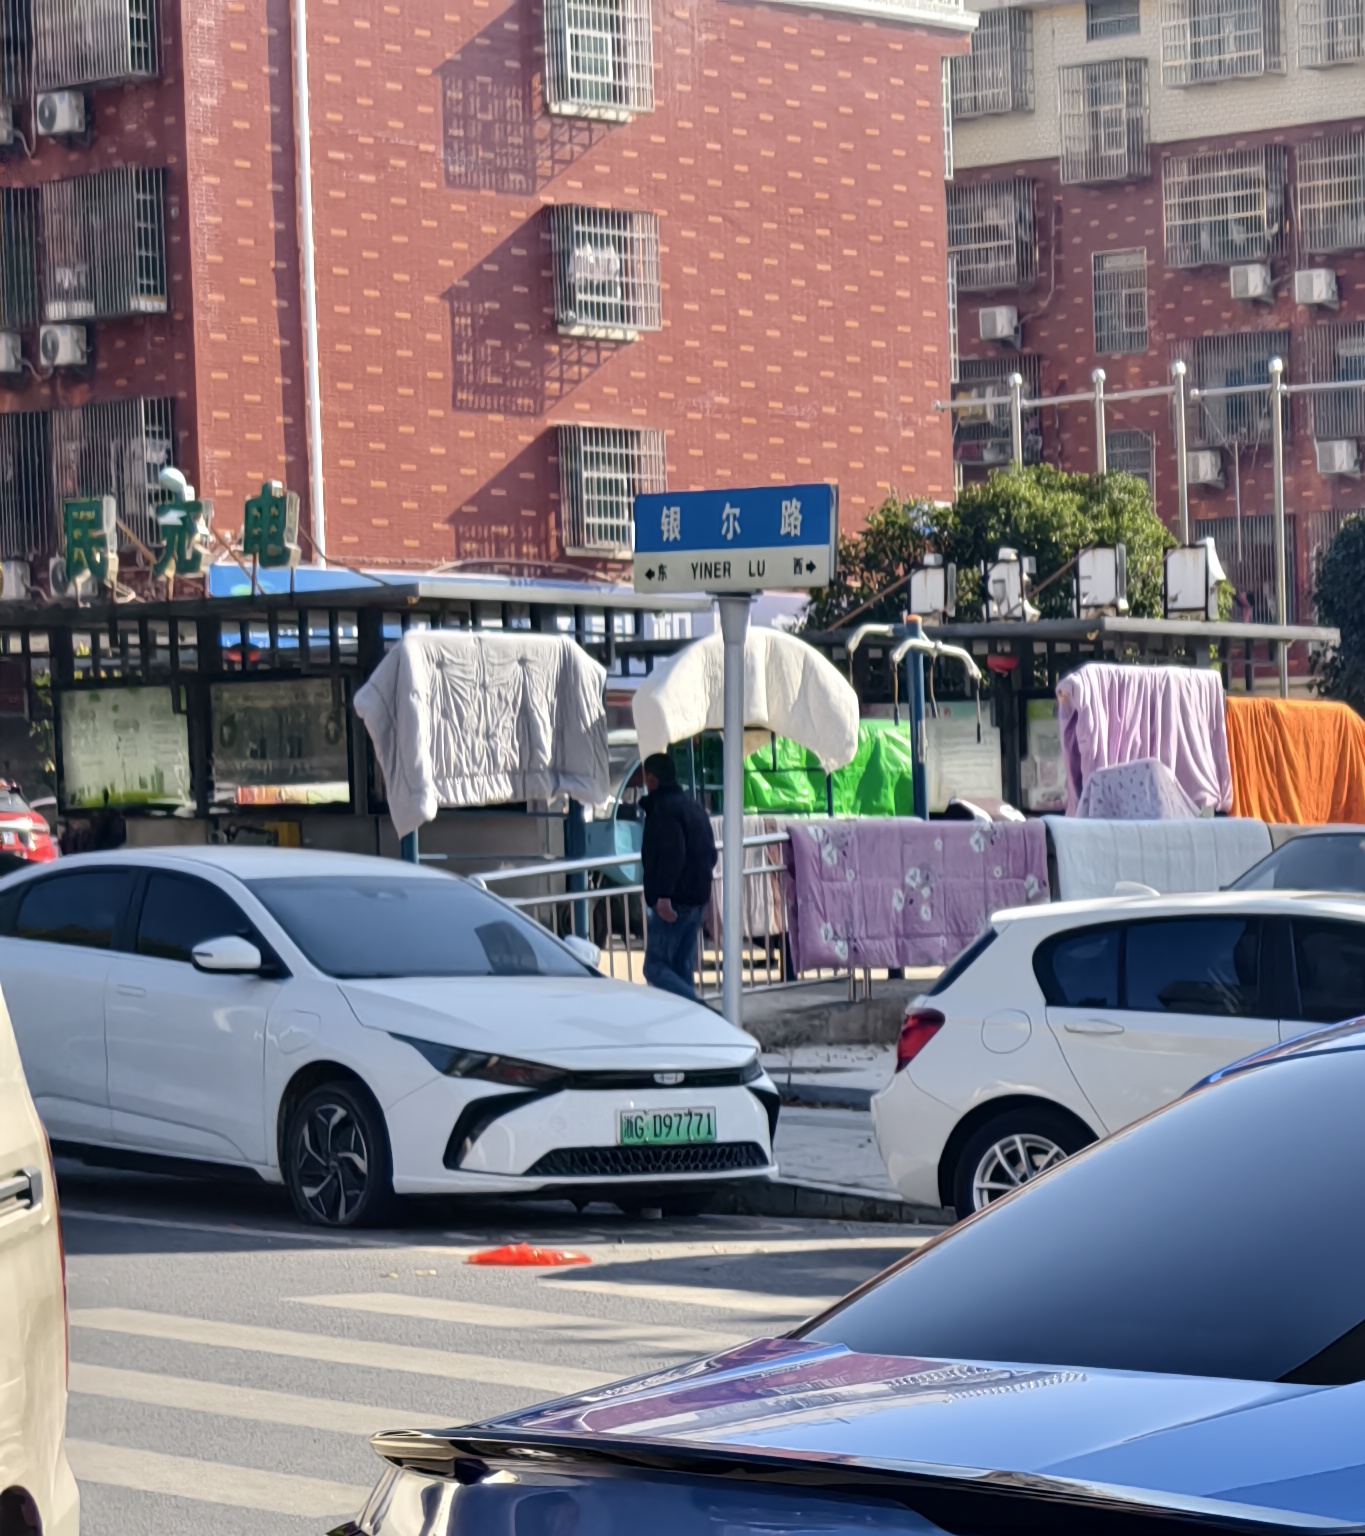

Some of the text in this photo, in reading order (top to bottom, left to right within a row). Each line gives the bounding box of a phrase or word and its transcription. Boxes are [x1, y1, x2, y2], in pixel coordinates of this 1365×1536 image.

[660, 497, 803, 542] 银尔路
[657, 562, 668, 582] 东
[691, 559, 766, 580] YINER LU
